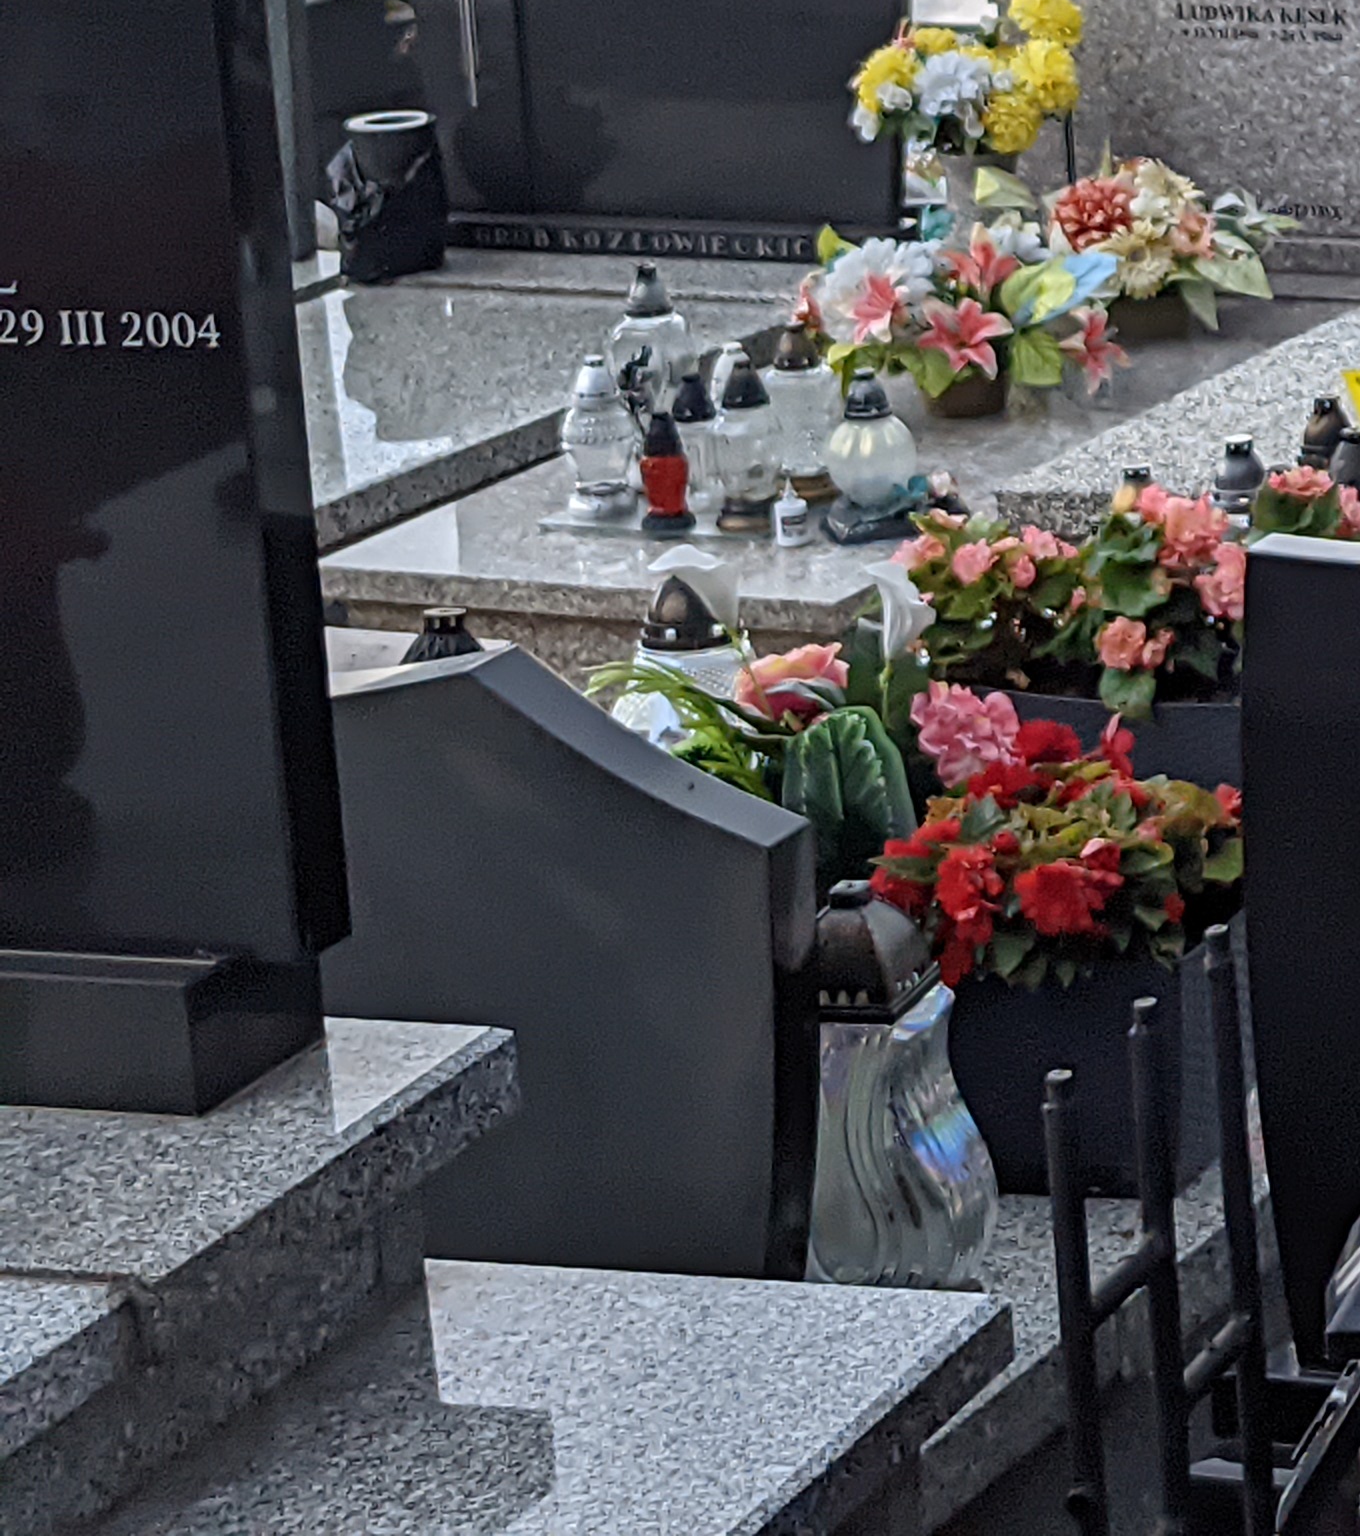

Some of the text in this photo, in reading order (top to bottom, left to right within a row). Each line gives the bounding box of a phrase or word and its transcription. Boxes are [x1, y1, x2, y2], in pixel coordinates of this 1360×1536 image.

[1176, 3, 1275, 24] LUDWIKA
[0, 309, 221, 349] 29 III 2004
